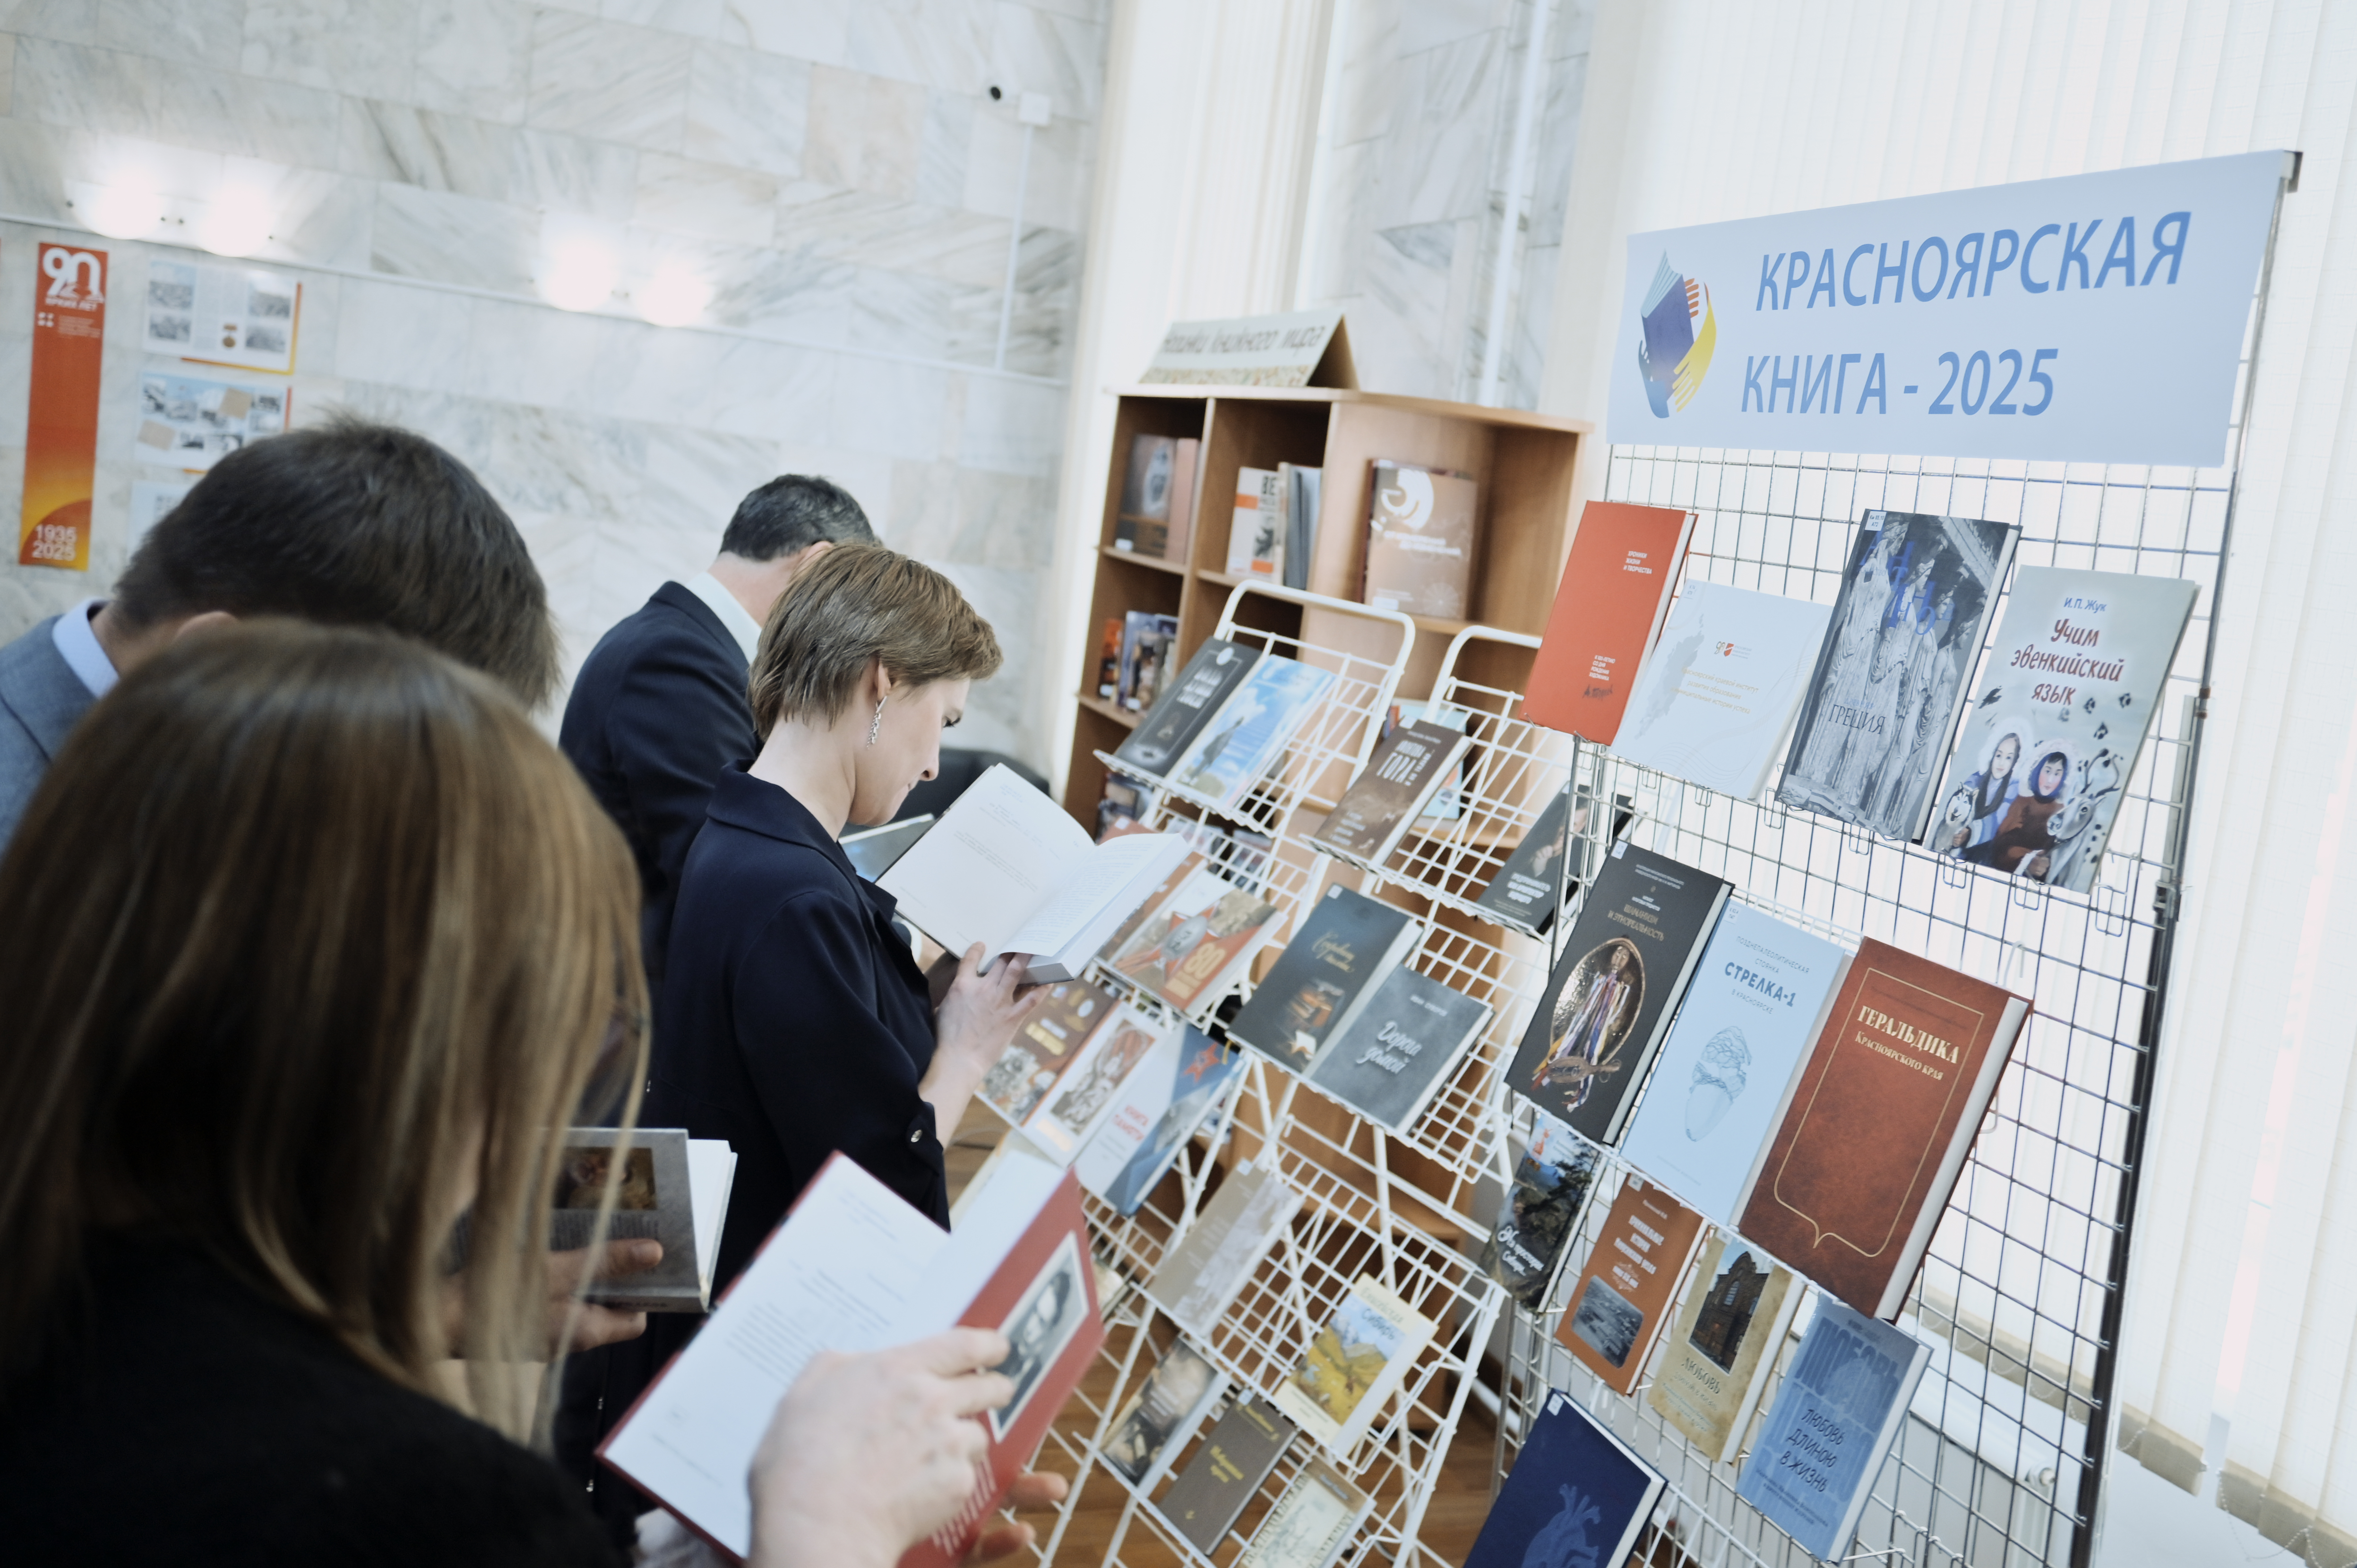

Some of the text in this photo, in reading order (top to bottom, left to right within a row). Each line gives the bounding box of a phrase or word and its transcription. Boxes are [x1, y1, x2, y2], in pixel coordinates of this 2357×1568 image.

[1756, 211, 2192, 311] КРАСНОЯРСКАЯ
[1741, 352, 1888, 414] КНИГА
[1928, 348, 2058, 417] 2025
[1627, 565, 1652, 574] ТВОРЧЕСТВА
[2084, 600, 2107, 613] Жук
[2051, 618, 2099, 647] Учим
[2011, 644, 2125, 682] эвенкийский
[1687, 681, 1742, 700] развития образования
[1712, 699, 1733, 709] истории
[1733, 705, 1750, 714] успеха
[2031, 683, 2076, 706] язык
[1828, 704, 1886, 734] ГРЕЦИЯ
[1376, 752, 1417, 783] ГОРА
[1736, 936, 1809, 974] ПОЗДНЕПАЛЕОЛИТИЧЕСКАЯ
[1755, 958, 1780, 974] СТОЯНКА
[1725, 962, 1796, 1007] СТРЕЛКА-1
[1736, 990, 1773, 1014] КРАСНОЯРСКЕ
[1857, 1005, 1960, 1064] ГЕРАЛЬДИКА
[1362, 1308, 1394, 1340] Сибирь
[1681, 1357, 1720, 1394] ЛЮБОВЬ
[1801, 1409, 1846, 1445] ЛЮБОВЬ
[1788, 1428, 1837, 1468] ДЛИНОЮ
[1781, 1451, 1830, 1492] В ЖИЗНЬ
